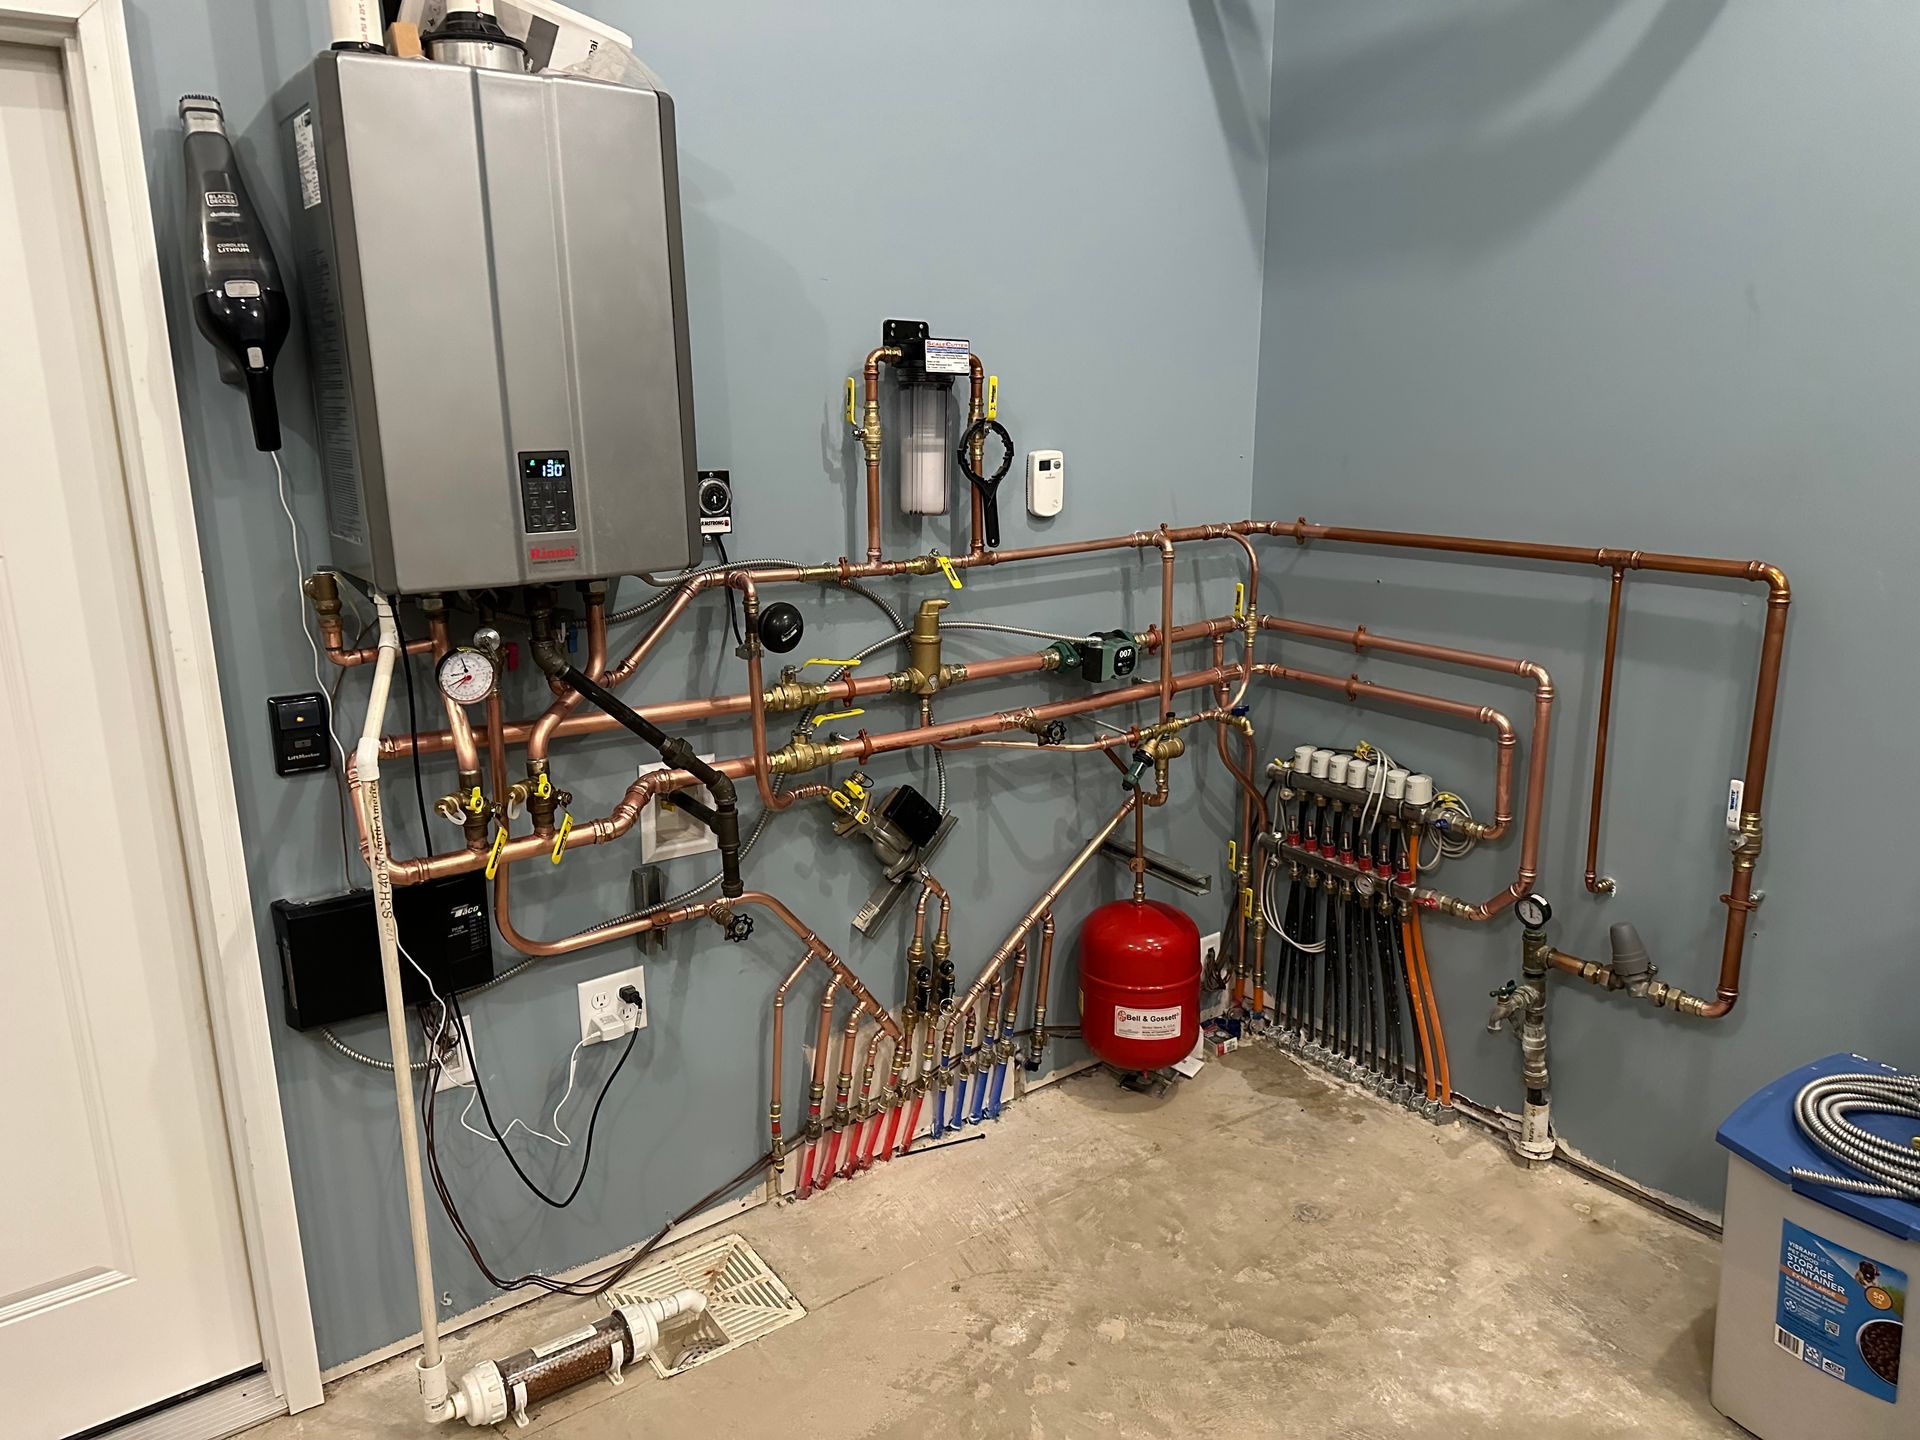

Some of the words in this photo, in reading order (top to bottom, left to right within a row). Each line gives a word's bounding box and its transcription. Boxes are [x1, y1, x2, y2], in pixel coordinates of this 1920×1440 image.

[1119, 649, 1132, 658] 007
[378, 873, 388, 889] 40
[379, 891, 393, 919] SCH
[1788, 1240, 1817, 1258] VIBRANT
[1788, 1247, 1799, 1256] PET
[1800, 1252, 1819, 1266] FOOD
[1787, 1252, 1834, 1282] STORAGE
[1787, 1261, 1845, 1295] CONTAINER
